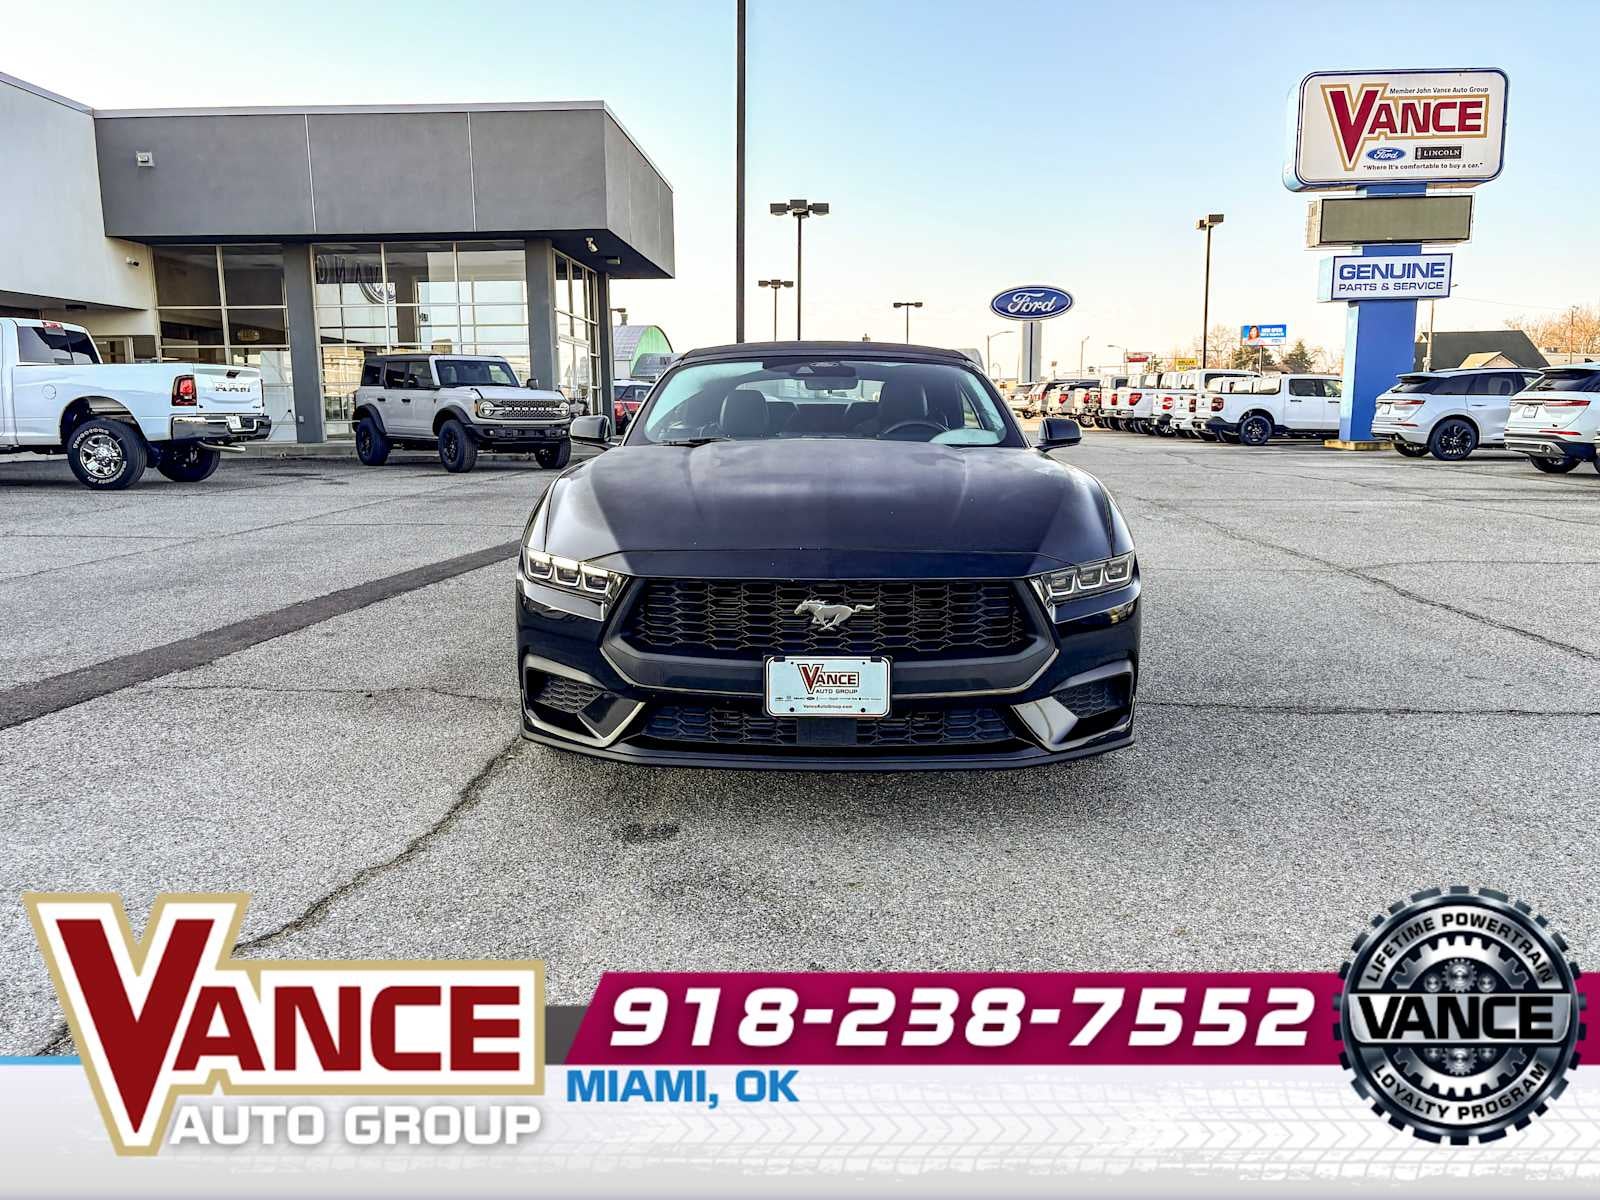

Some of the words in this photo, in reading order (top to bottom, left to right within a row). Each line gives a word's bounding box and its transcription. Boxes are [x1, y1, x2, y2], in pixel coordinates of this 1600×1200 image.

[1469, 86, 1489, 94] Group
[1329, 90, 1483, 164] VANCE
[1374, 149, 1399, 159] Ford
[1423, 149, 1461, 157] LINCOLN
[1339, 262, 1446, 280] GENUINE
[1338, 283, 1377, 291] PARTS
[1380, 282, 1390, 291] &
[1393, 281, 1444, 290] SERVICE
[1007, 292, 1057, 313] Ford
[215, 382, 250, 392] RAM
[801, 666, 857, 689] VANCE
